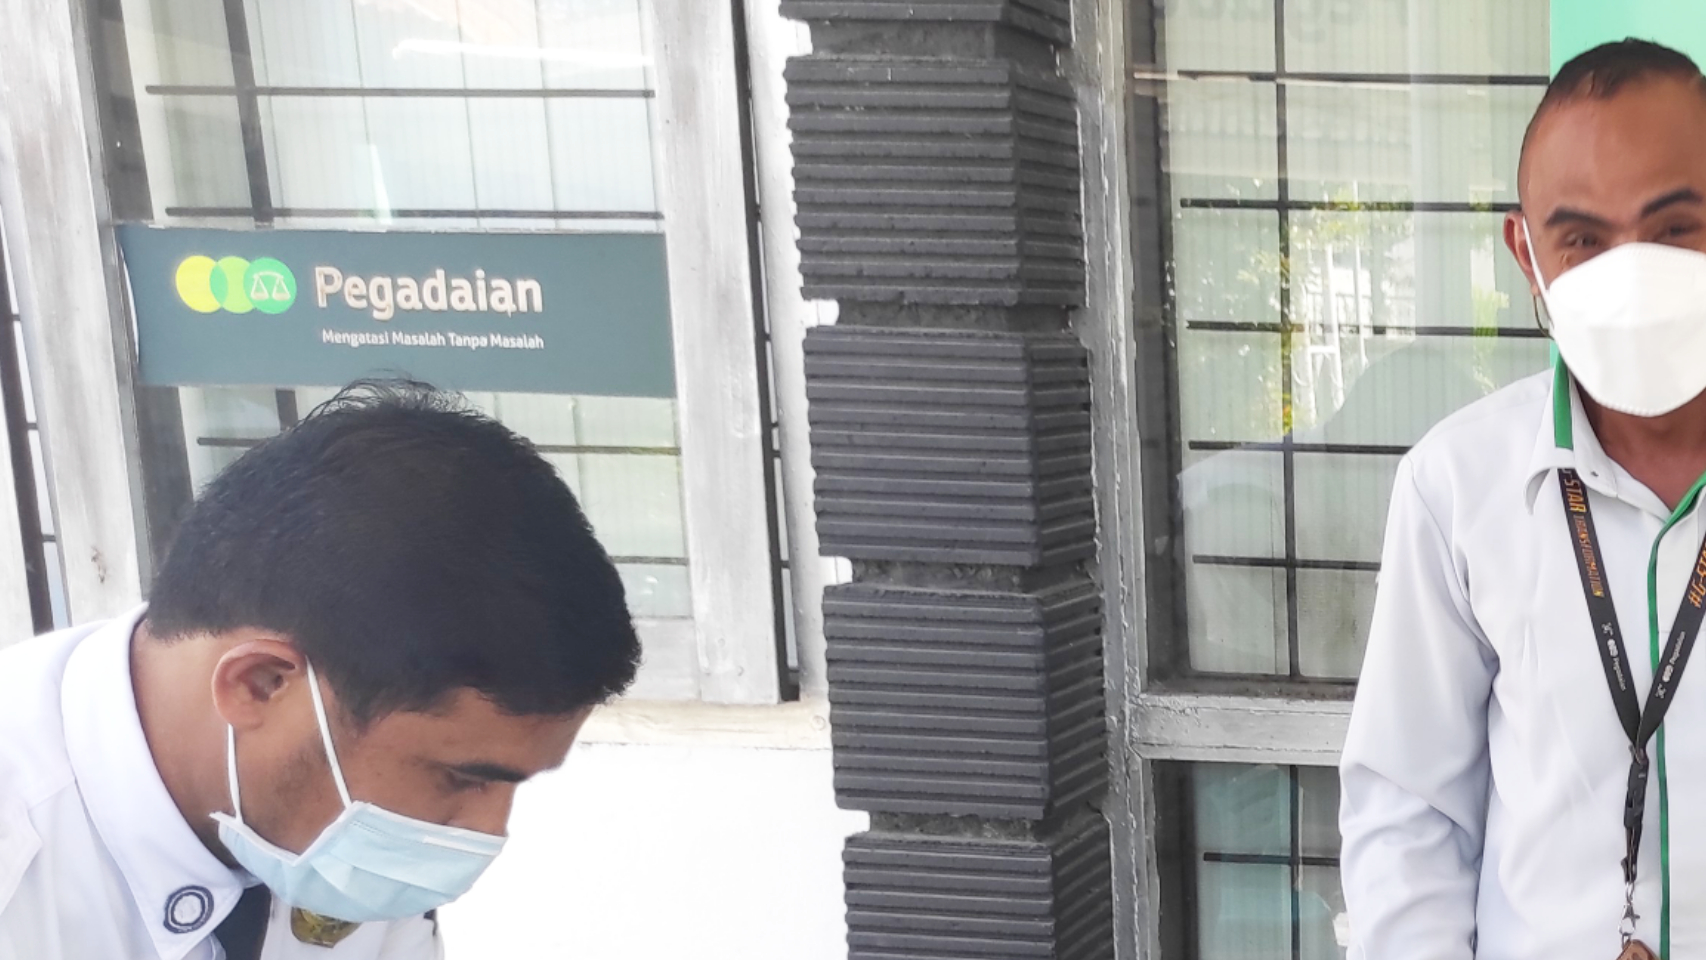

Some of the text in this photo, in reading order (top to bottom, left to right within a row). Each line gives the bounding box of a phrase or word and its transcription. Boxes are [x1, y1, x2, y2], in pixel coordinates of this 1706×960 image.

[315, 265, 543, 321] Pegadaian
[322, 329, 544, 351] Mengatasi Masalah Tanpa Masalah
